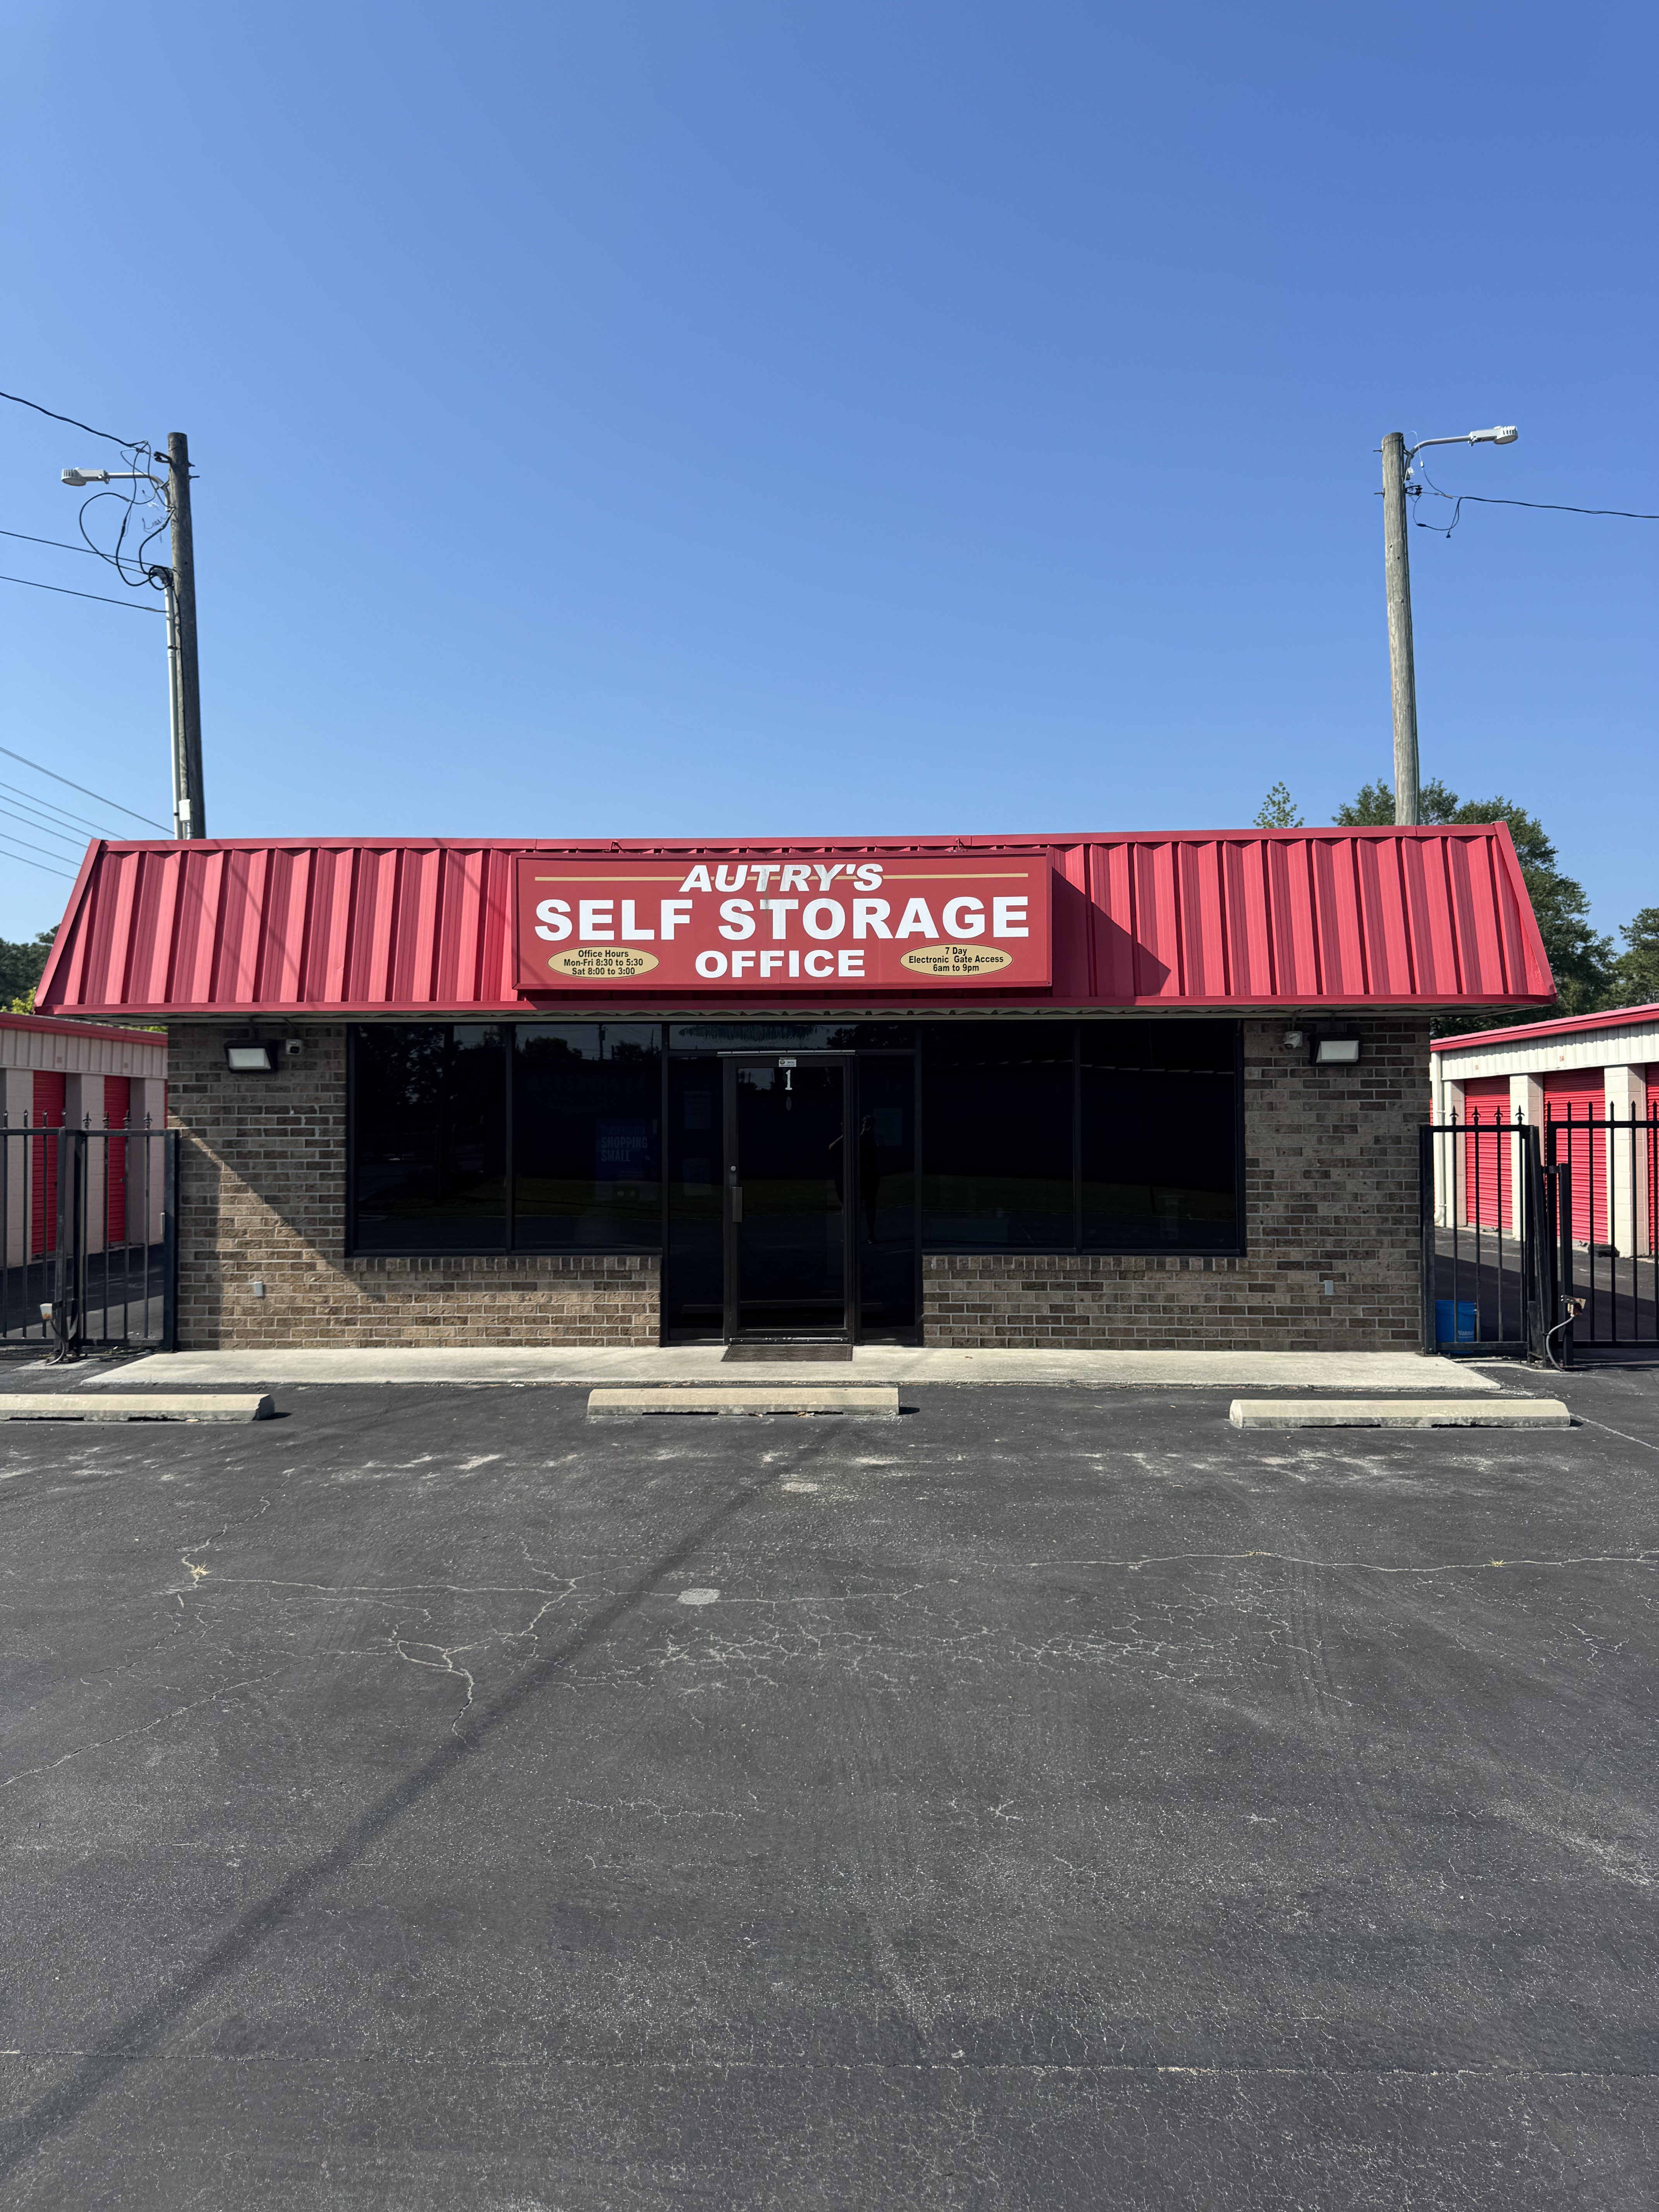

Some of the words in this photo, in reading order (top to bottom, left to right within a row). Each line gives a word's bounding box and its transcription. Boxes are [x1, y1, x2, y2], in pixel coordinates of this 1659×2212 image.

[678, 864, 883, 892] AUTRY'S
[535, 899, 693, 941] SELF
[718, 896, 1029, 941] STORAGE
[952, 947, 967, 956] Day
[695, 950, 865, 979] OFFICE
[954, 955, 972, 963] Gate
[962, 964, 979, 973] 9pm
[785, 1070, 792, 1090] 1
[601, 1136, 647, 1148] SHOPPING
[601, 1149, 631, 1161] SMALL
